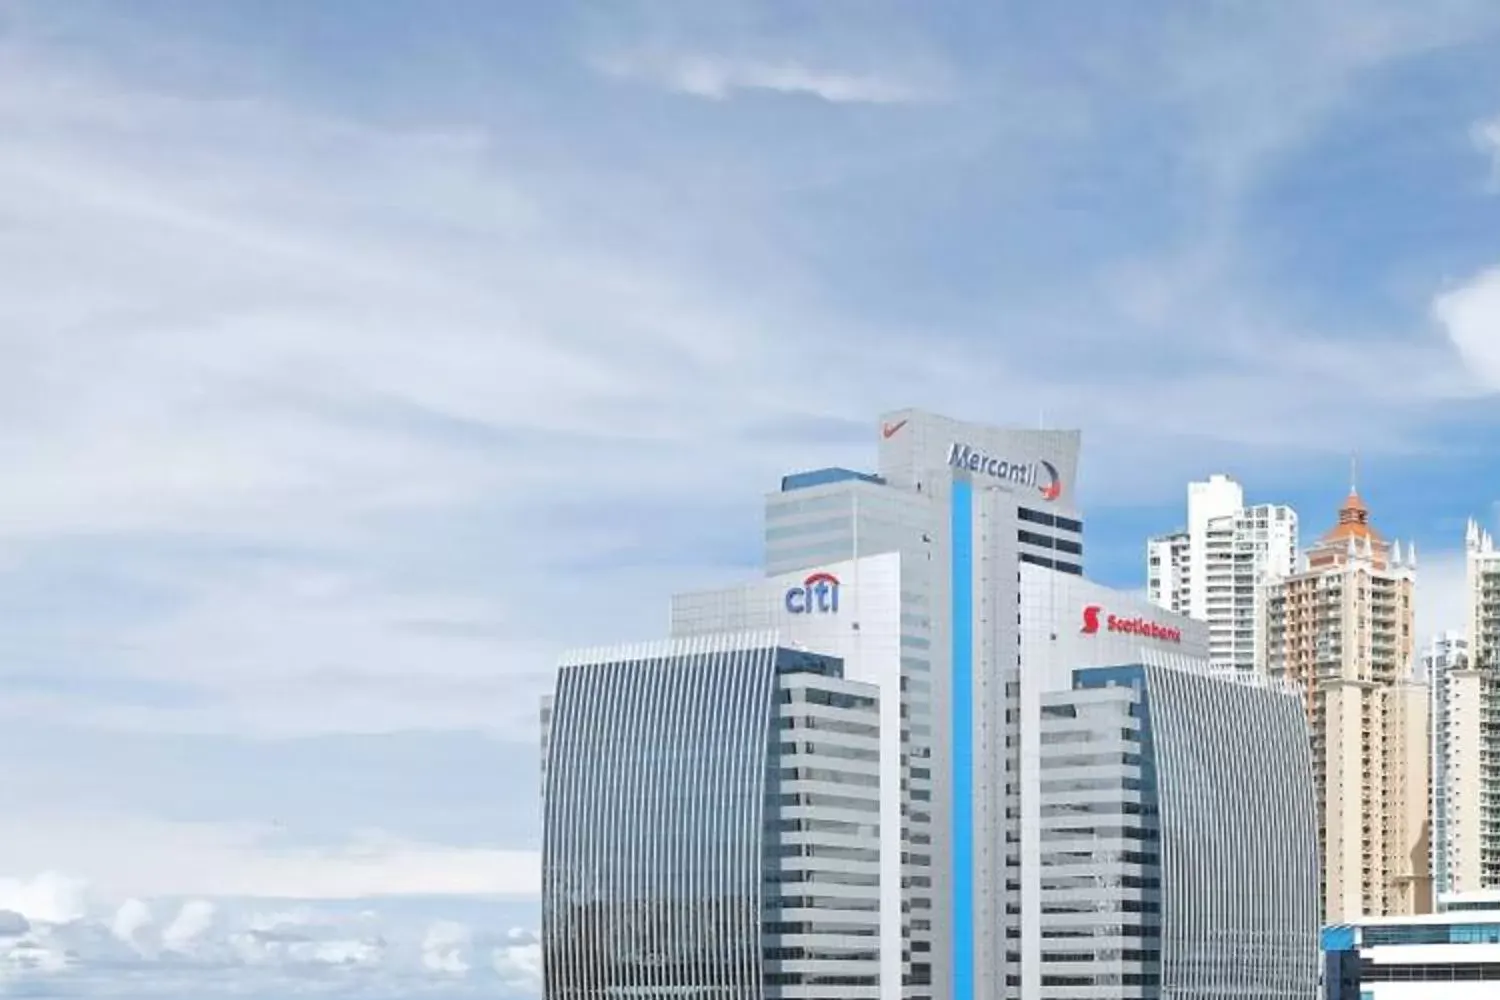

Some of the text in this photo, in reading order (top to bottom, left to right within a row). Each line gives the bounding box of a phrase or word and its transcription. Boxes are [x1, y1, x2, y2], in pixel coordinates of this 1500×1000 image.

[948, 442, 1038, 487] Mercantil
[785, 574, 840, 614] citi
[1107, 613, 1181, 643] Scotiabank
